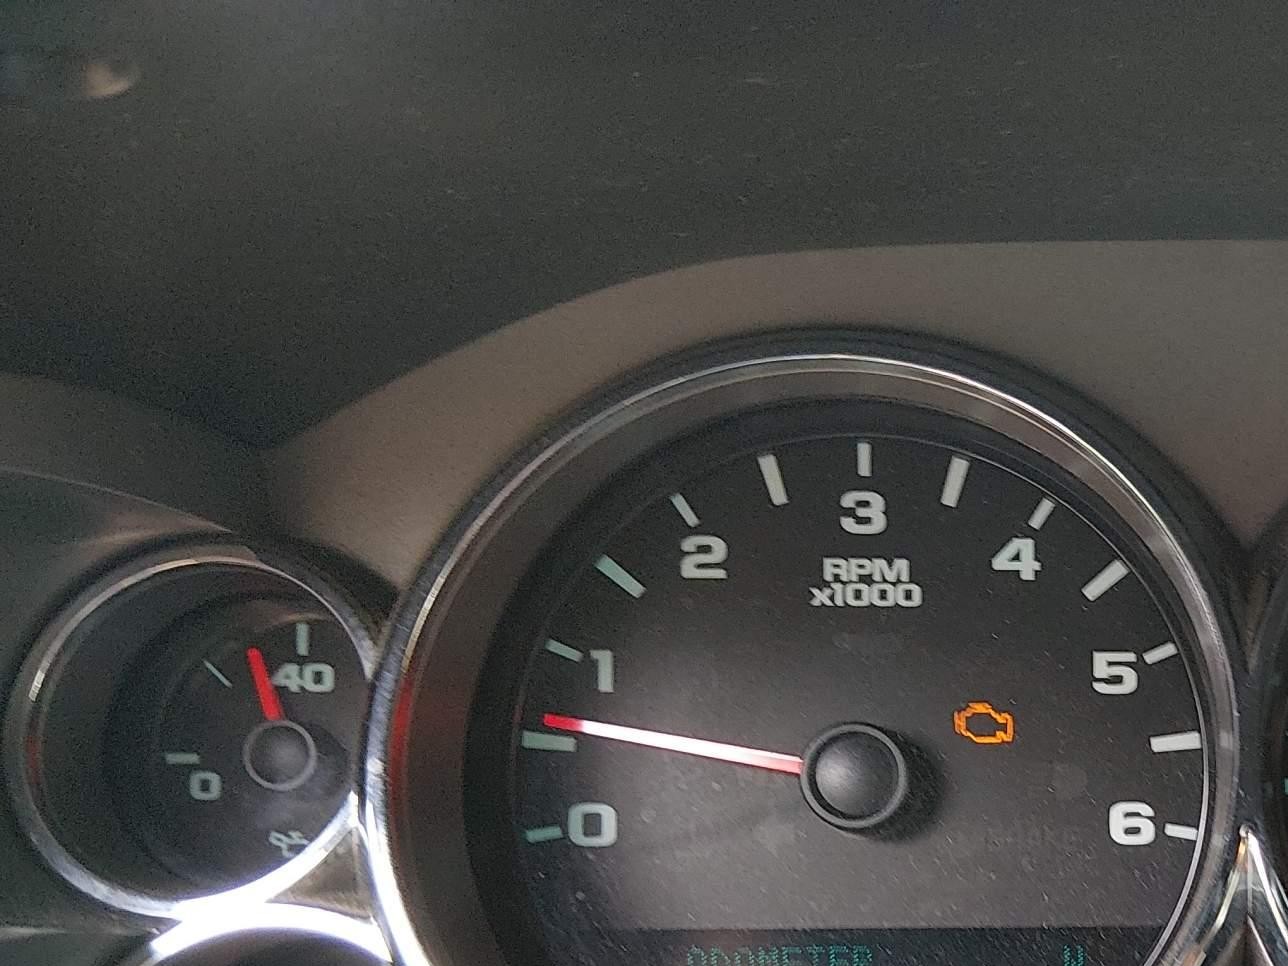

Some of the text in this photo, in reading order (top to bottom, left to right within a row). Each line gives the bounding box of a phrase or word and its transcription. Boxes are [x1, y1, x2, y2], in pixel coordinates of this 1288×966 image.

[839, 490, 888, 535] 3
[680, 534, 729, 579] 2
[822, 557, 911, 583] RPM
[991, 537, 1042, 581] 4
[808, 582, 923, 608] x1000
[270, 662, 335, 692] 40
[590, 650, 614, 693] 1
[1092, 651, 1139, 695] 5
[189, 771, 222, 800] 0
[567, 802, 619, 847] 0
[1109, 801, 1156, 846] 6
